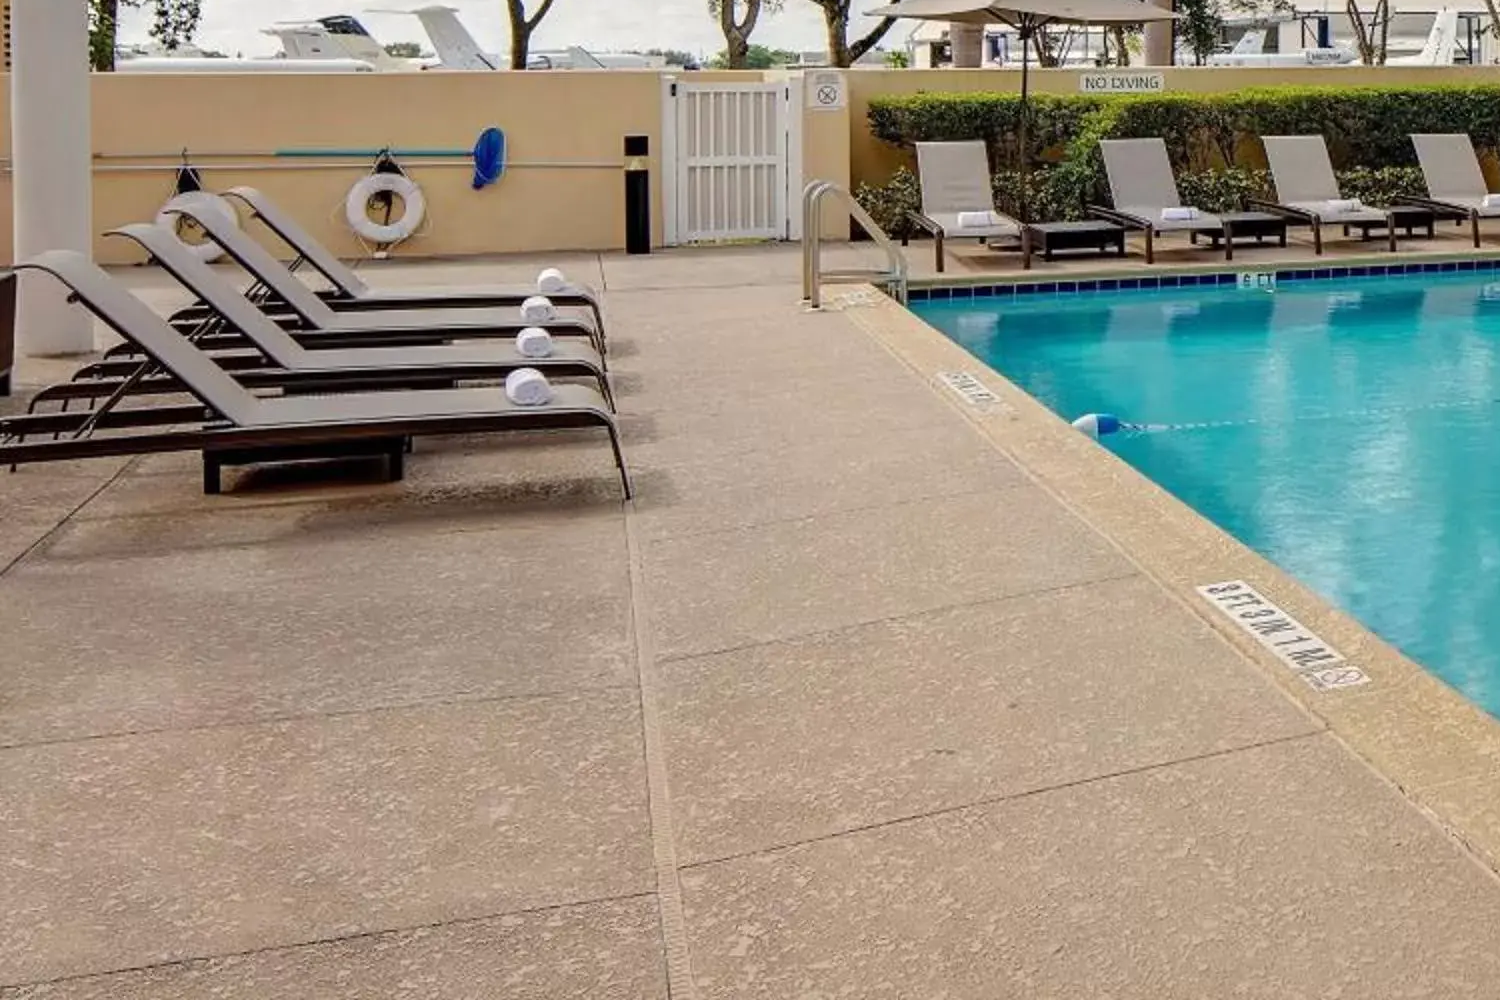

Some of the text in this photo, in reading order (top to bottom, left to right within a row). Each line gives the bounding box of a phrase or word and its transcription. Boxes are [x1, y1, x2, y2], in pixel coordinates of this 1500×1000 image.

[1085, 76, 1159, 89] NO DIVING
[1249, 617, 1298, 636] IN
